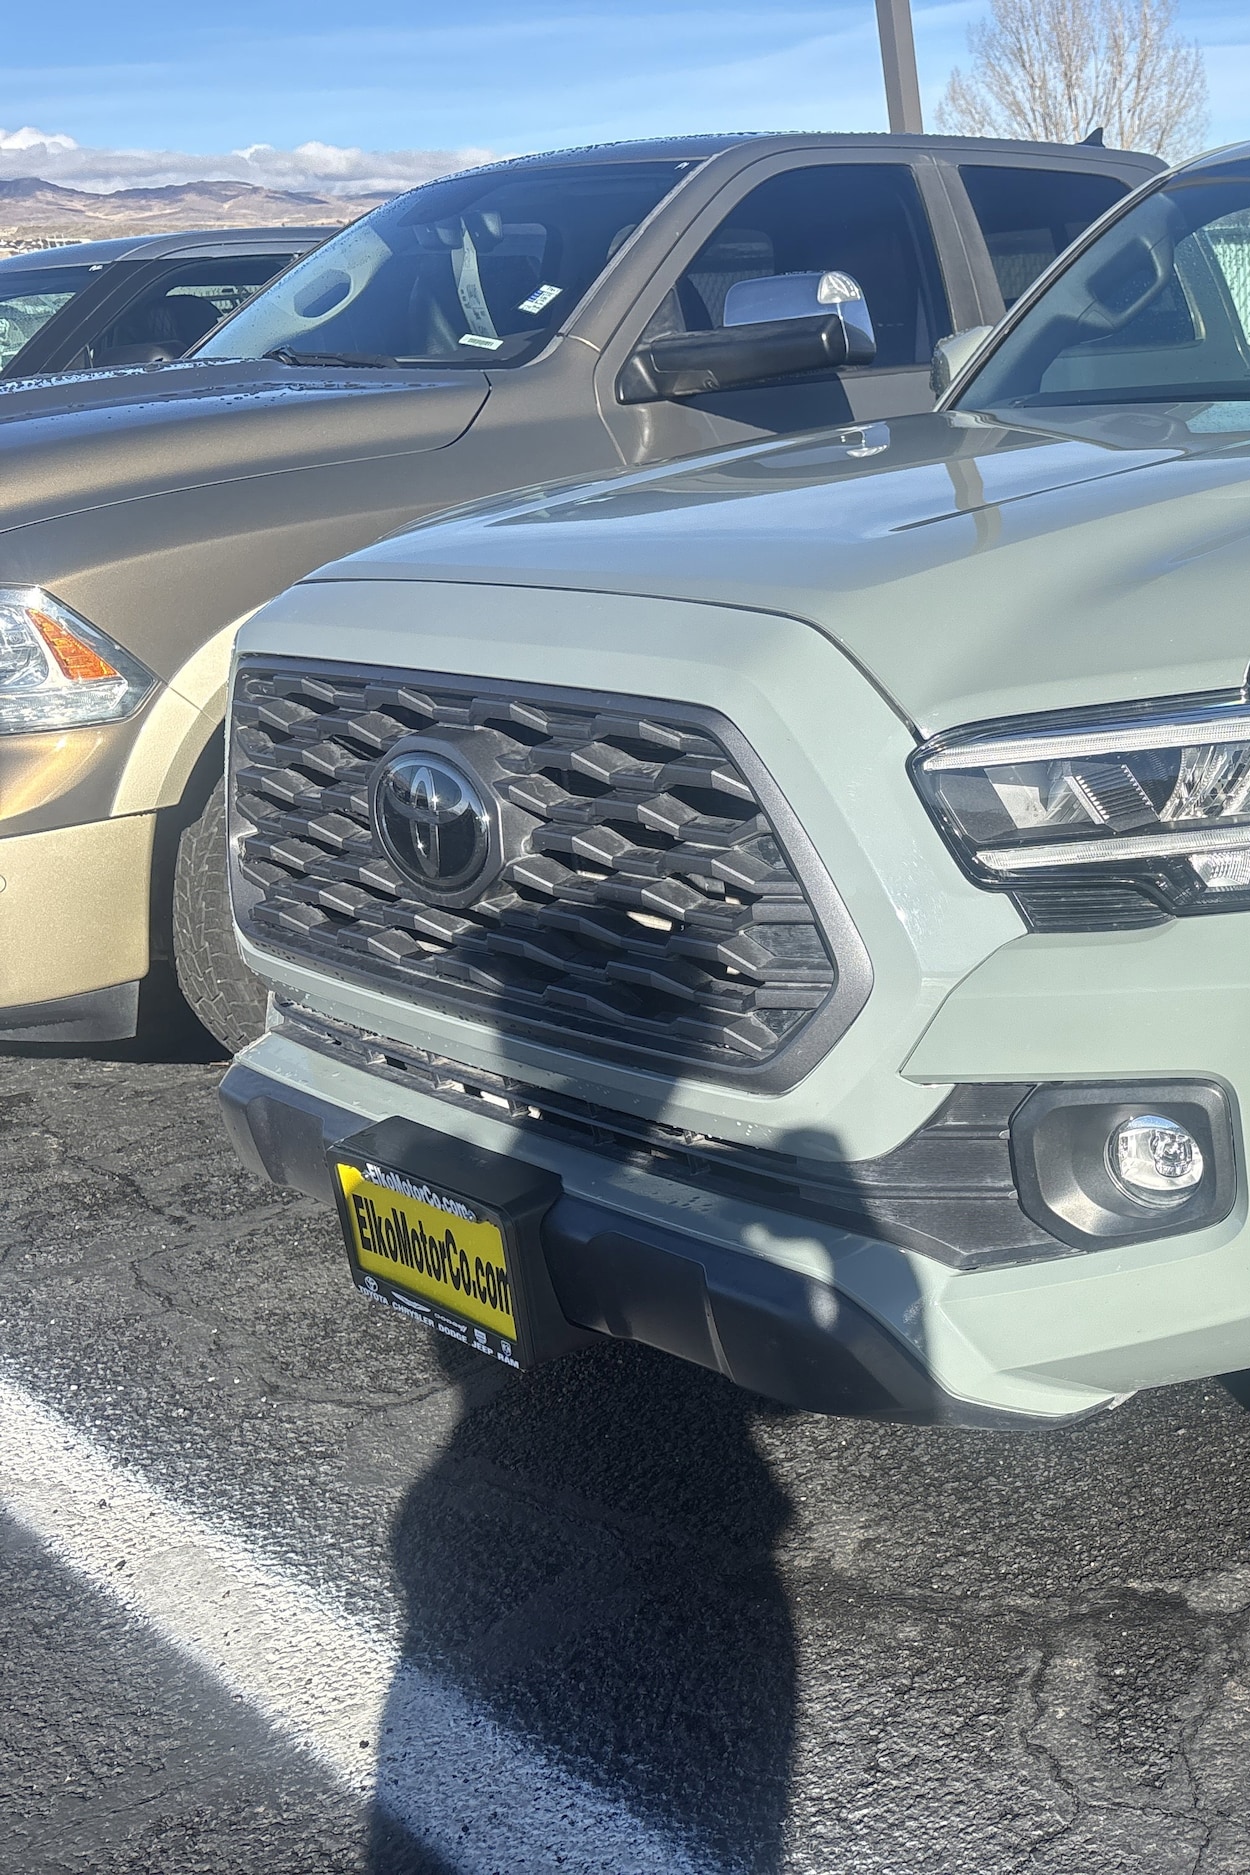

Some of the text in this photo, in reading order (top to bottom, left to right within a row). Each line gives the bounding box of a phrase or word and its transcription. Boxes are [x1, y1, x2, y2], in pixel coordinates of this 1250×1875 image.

[366, 1163, 470, 1221] ElkoMotorCo.com
[352, 1193, 513, 1316] ElkoMotorCo.com
[358, 1285, 389, 1306] TOYOTA
[391, 1301, 435, 1329] CHRYSLER
[438, 1323, 468, 1343] DODGE
[471, 1340, 494, 1356] JEEP
[497, 1352, 520, 1370] RAM
